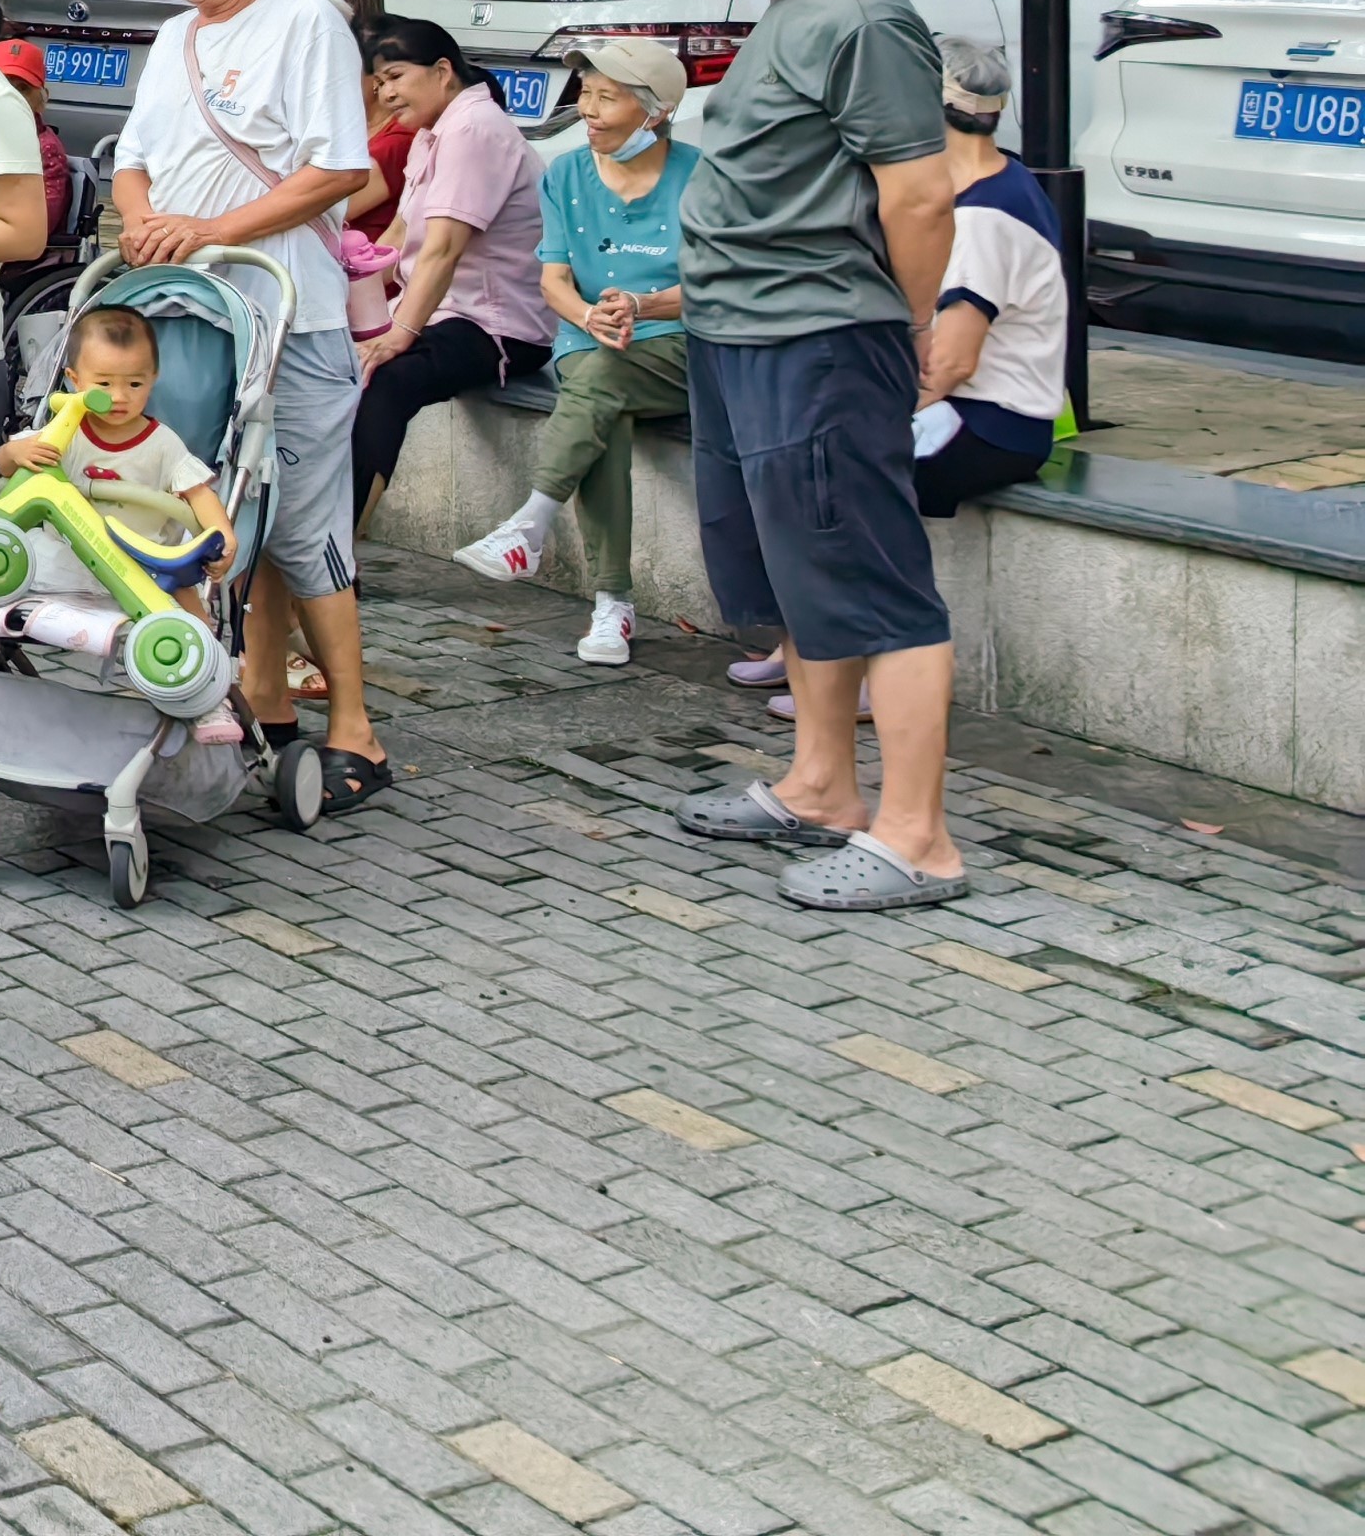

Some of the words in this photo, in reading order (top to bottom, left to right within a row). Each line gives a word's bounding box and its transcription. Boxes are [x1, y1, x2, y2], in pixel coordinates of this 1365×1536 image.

[26, 25, 132, 38] AVALON
[219, 69, 242, 99] 5
[619, 243, 669, 257] MICKEY
[60, 500, 95, 542] SCOOTER
[93, 535, 110, 557] FOR
[107, 552, 128, 578] KIDS
